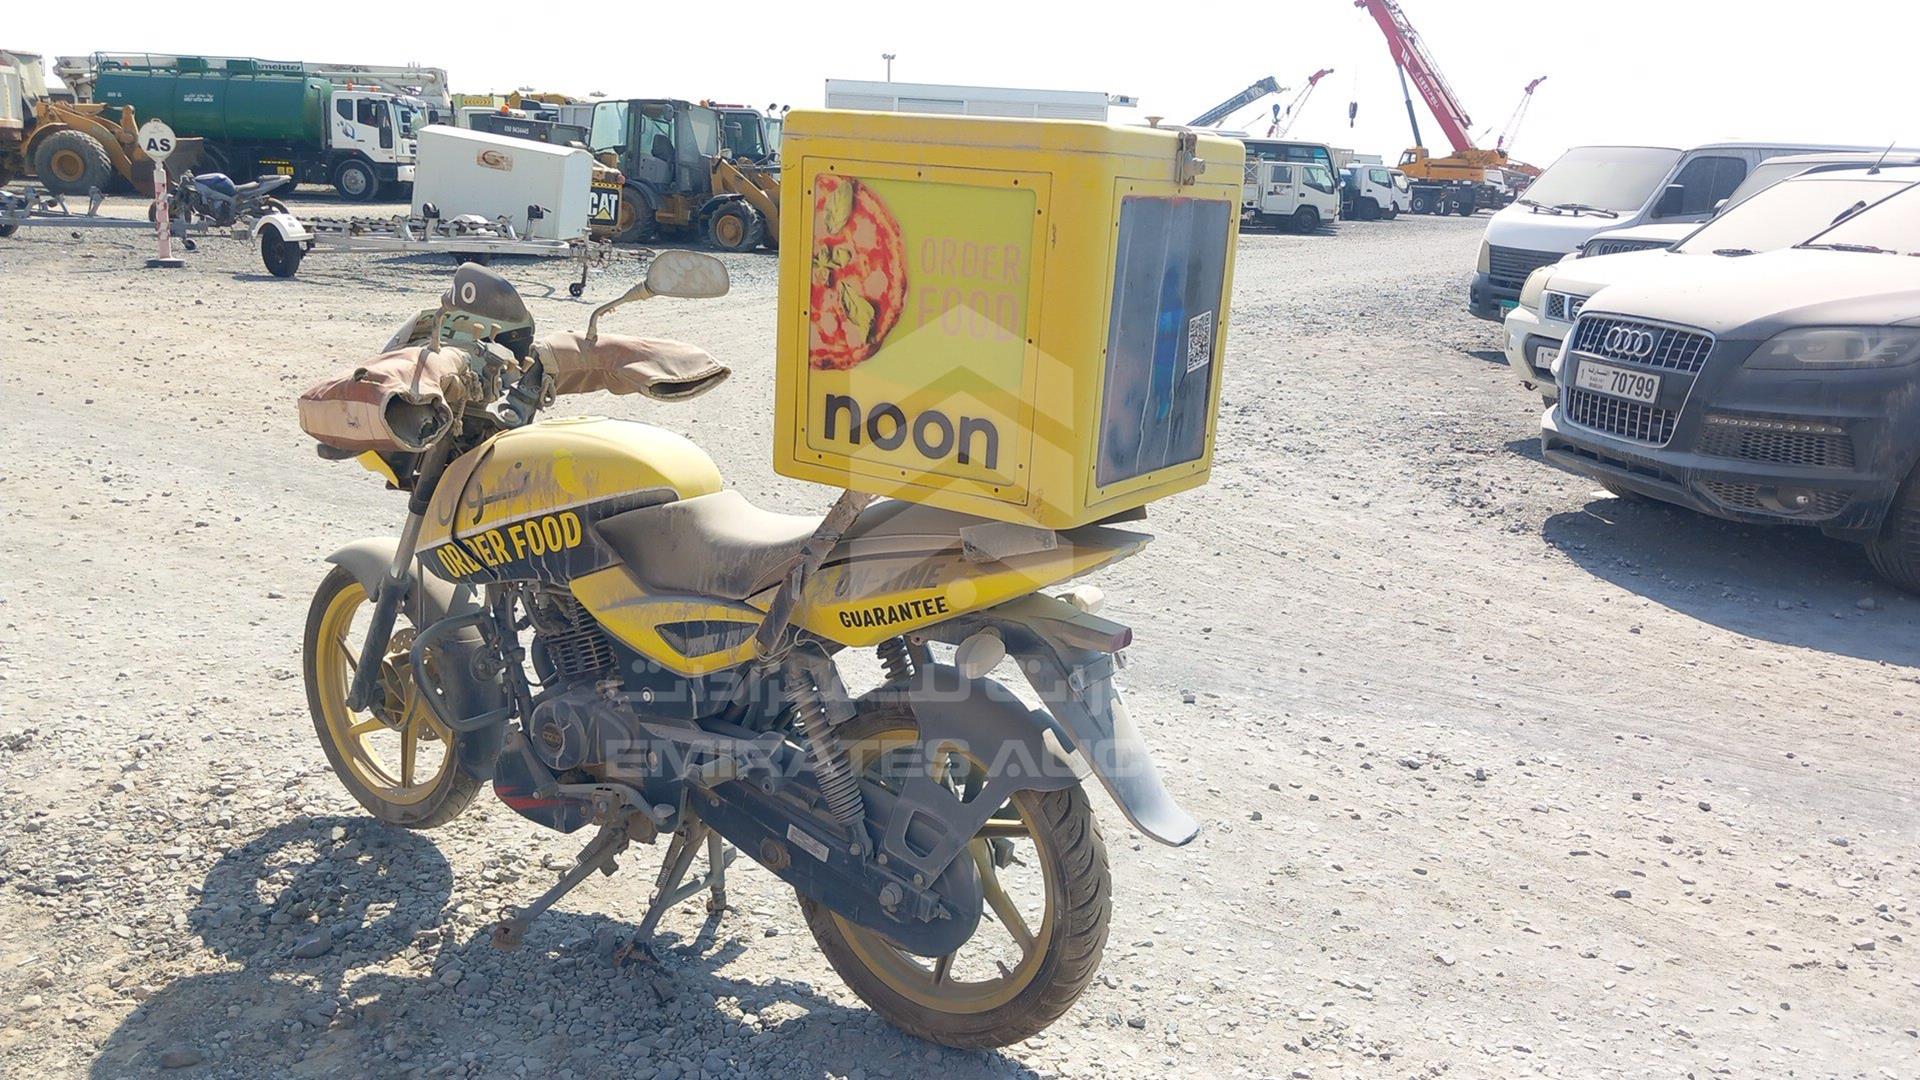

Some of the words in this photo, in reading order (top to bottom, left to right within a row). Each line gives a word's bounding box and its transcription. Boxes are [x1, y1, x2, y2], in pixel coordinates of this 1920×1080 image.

[147, 137, 171, 152] AS
[588, 191, 619, 221] CAT
[920, 236, 1022, 285] ORDER
[917, 286, 1020, 342] FOOD
[1610, 370, 1655, 399] 70799
[824, 393, 999, 470] noon
[436, 528, 512, 578] ORDER
[509, 511, 583, 560] FOOD
[839, 595, 949, 628] GUARANTEE
